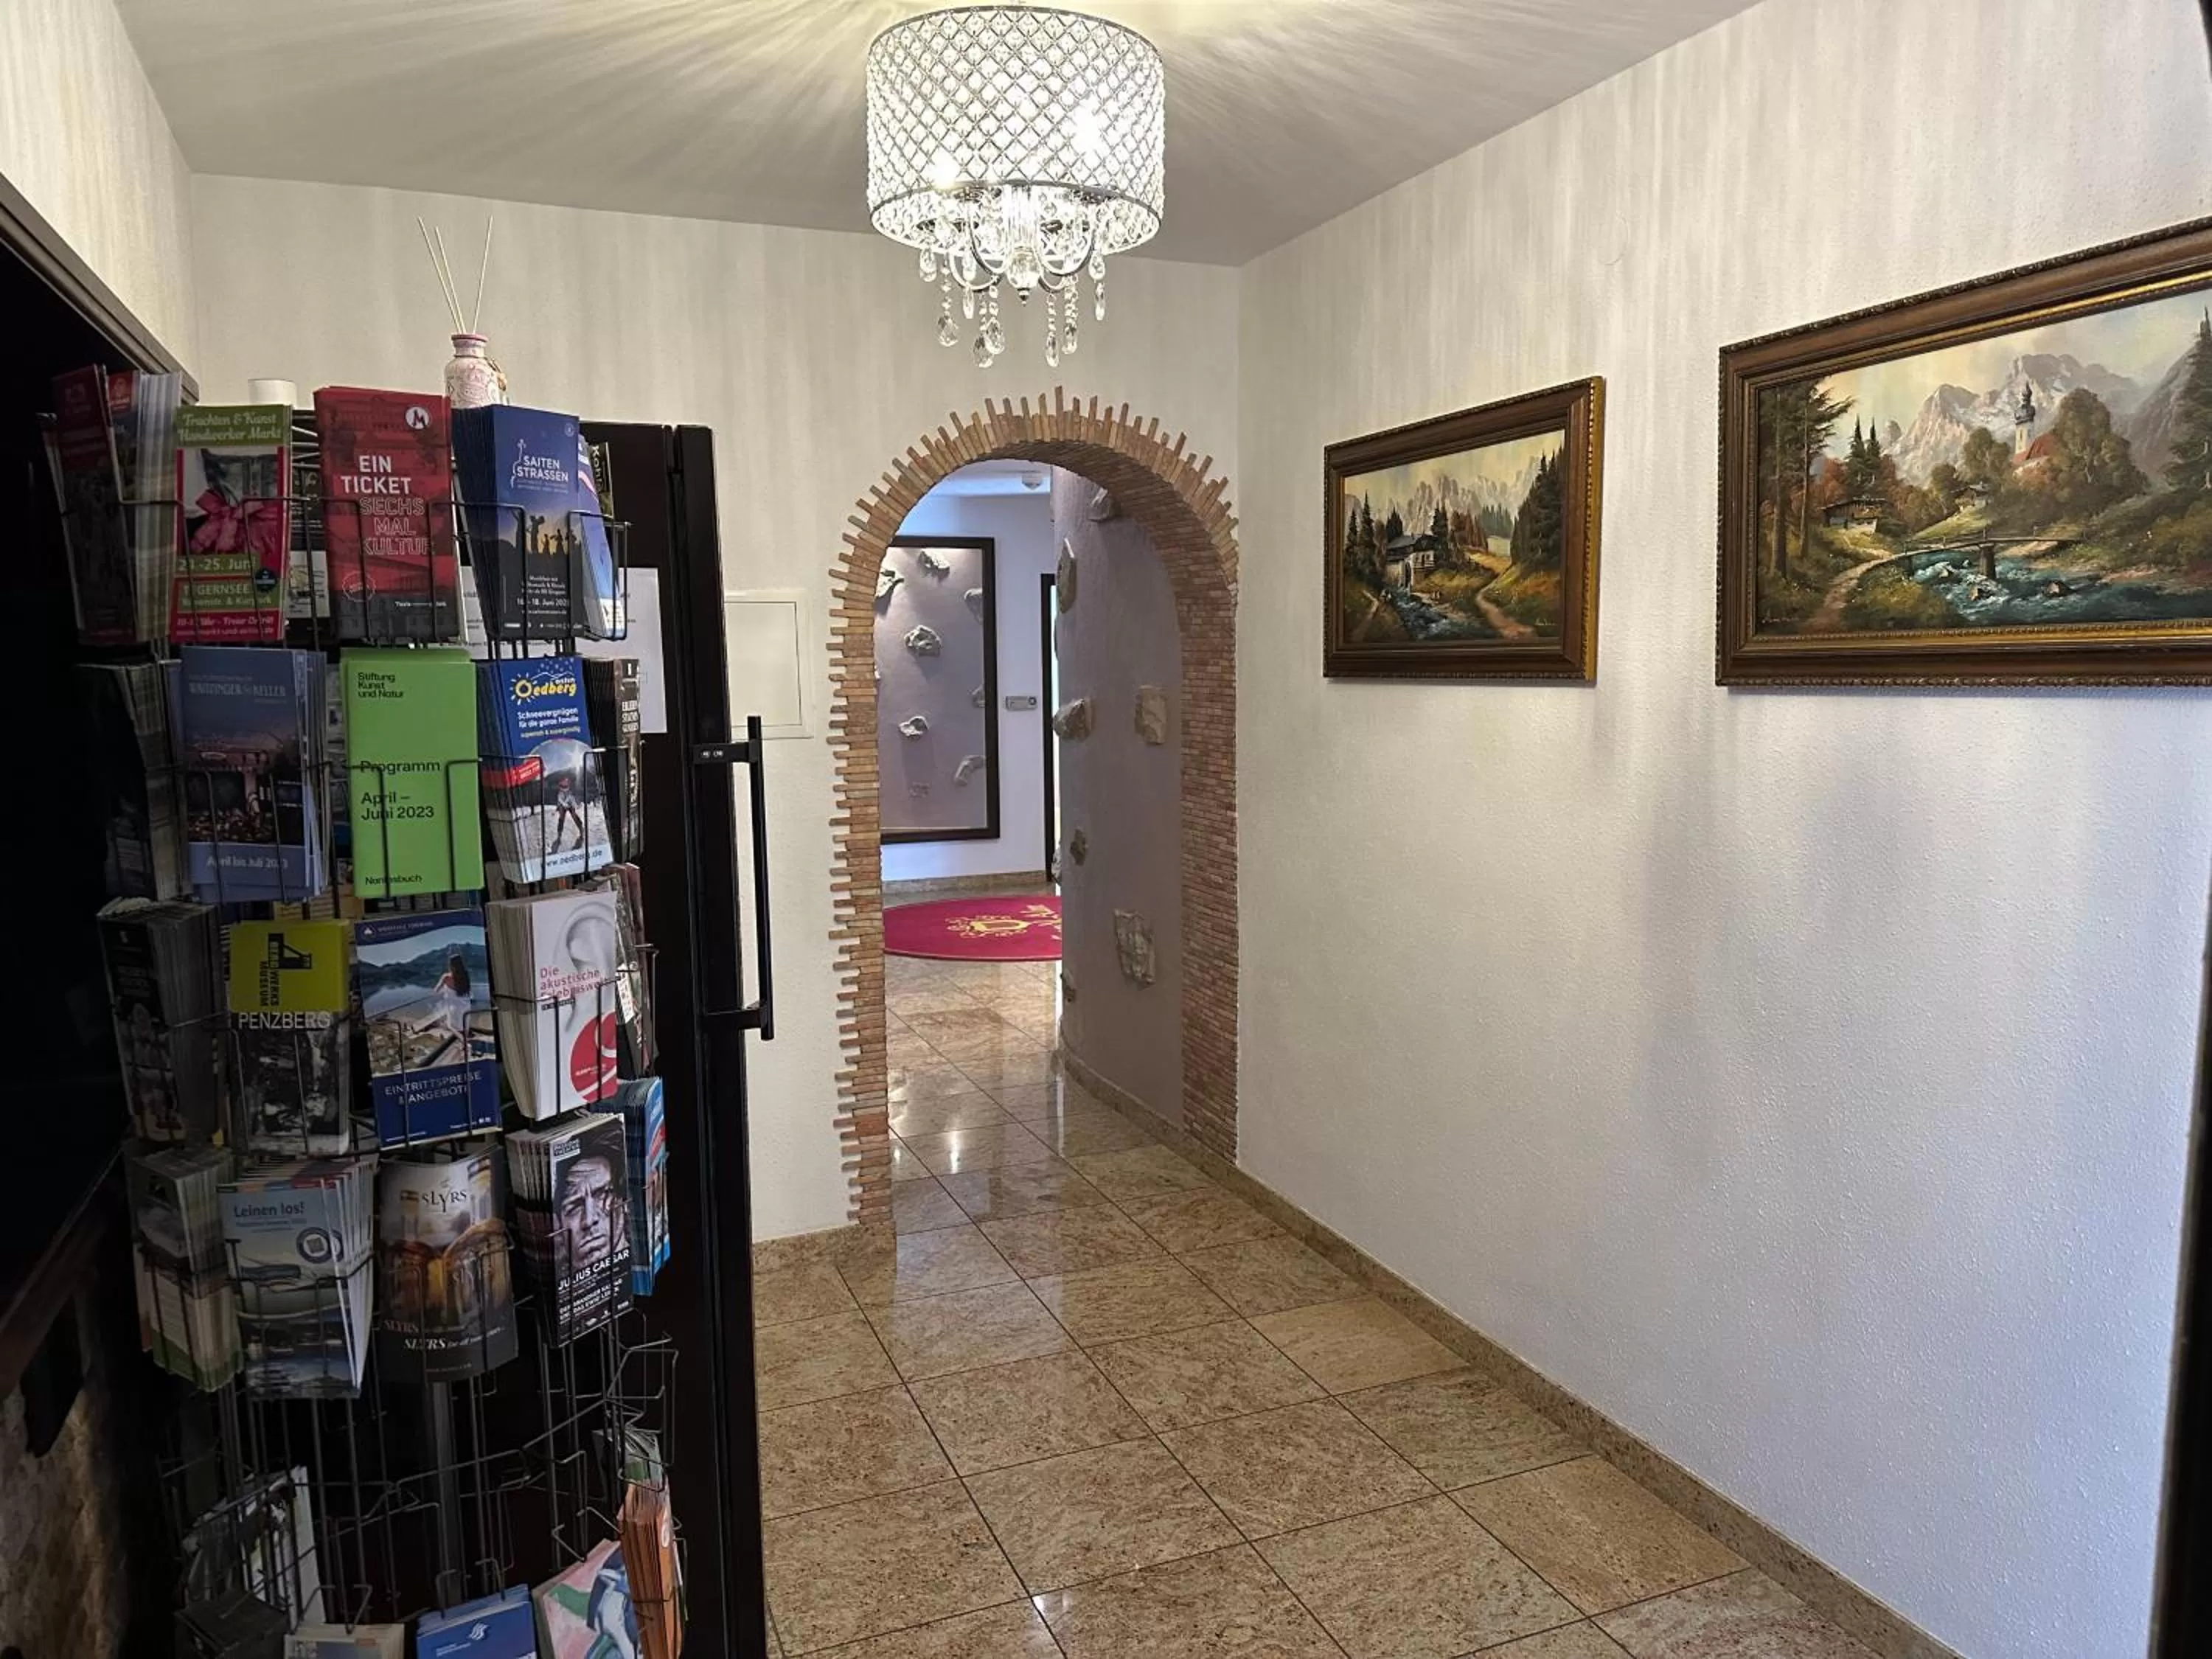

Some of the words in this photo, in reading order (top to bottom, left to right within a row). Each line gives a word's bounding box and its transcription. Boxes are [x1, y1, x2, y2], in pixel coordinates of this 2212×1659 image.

[182, 412, 231, 426] Trachten
[233, 414, 243, 425] &
[244, 411, 278, 425] Kunst
[177, 428, 246, 442] Handwerker
[247, 425, 282, 440] Markt
[358, 455, 392, 473] EIN
[523, 455, 560, 470] SAITEN
[517, 467, 568, 483] STRASSEN
[340, 475, 413, 495] TICKET
[359, 496, 425, 516] SECHS
[373, 517, 417, 536] MAL
[183, 582, 251, 596] TGERNSEE
[235, 597, 272, 609] Kurprk
[555, 597, 570, 608] 202
[358, 672, 396, 684] Stiftung
[358, 681, 385, 690] Kunst
[358, 690, 377, 698] und
[379, 690, 404, 699] Natur
[515, 678, 577, 699] Oedberg
[360, 760, 441, 776] Programm
[361, 791, 397, 807] April
[361, 806, 394, 821] Juni
[397, 805, 434, 819] 2023
[206, 855, 232, 869] Aril
[365, 874, 423, 886] Nanesbuch
[540, 967, 560, 978] Die
[540, 969, 601, 990] akustische
[260, 961, 269, 1006] MUSEUM
[238, 1011, 331, 1030] PENZBERG
[384, 1070, 482, 1096] EINTRITTSPREISE
[408, 1085, 470, 1105] ANGEBOT
[234, 1203, 278, 1217] Leinen
[280, 1200, 305, 1215] los!
[422, 1189, 468, 1213] SLYRS
[557, 1267, 591, 1291] JUIUS
[591, 1249, 630, 1273] CAESAR
